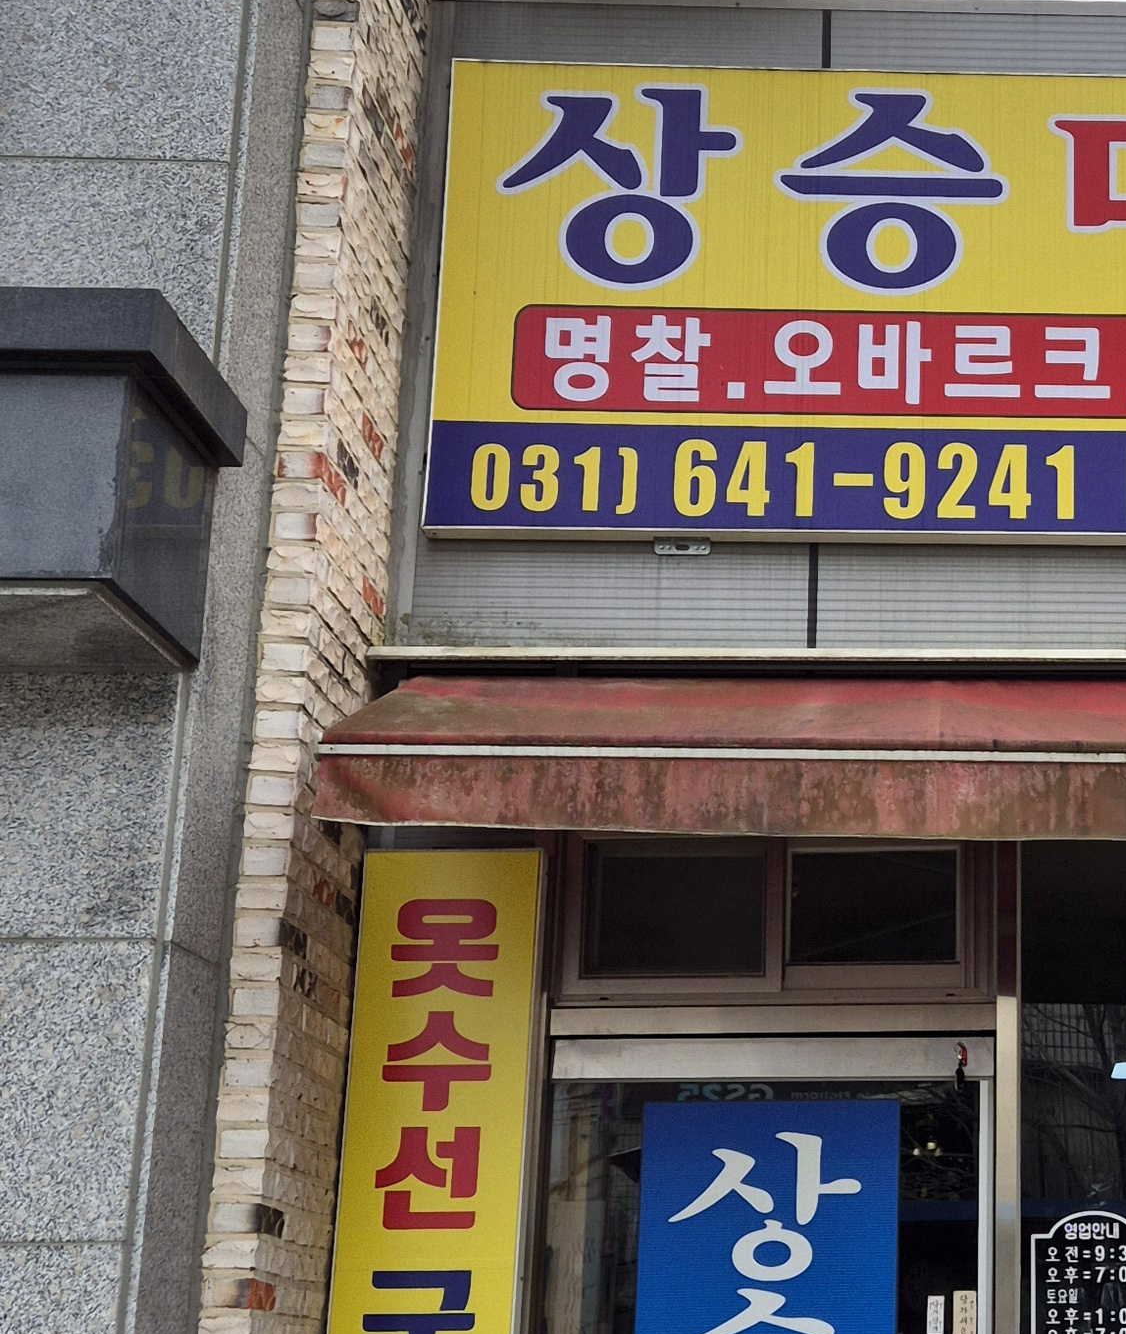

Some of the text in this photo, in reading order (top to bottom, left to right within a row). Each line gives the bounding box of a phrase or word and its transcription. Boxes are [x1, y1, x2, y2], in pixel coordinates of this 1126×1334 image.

[470, 442, 639, 516] 031)
[673, 438, 1075, 521] 641-9241
[375, 898, 499, 1231] 옷수선
[1064, 1222, 1120, 1240] 영업안내
[1046, 1288, 1079, 1304] 토요일
